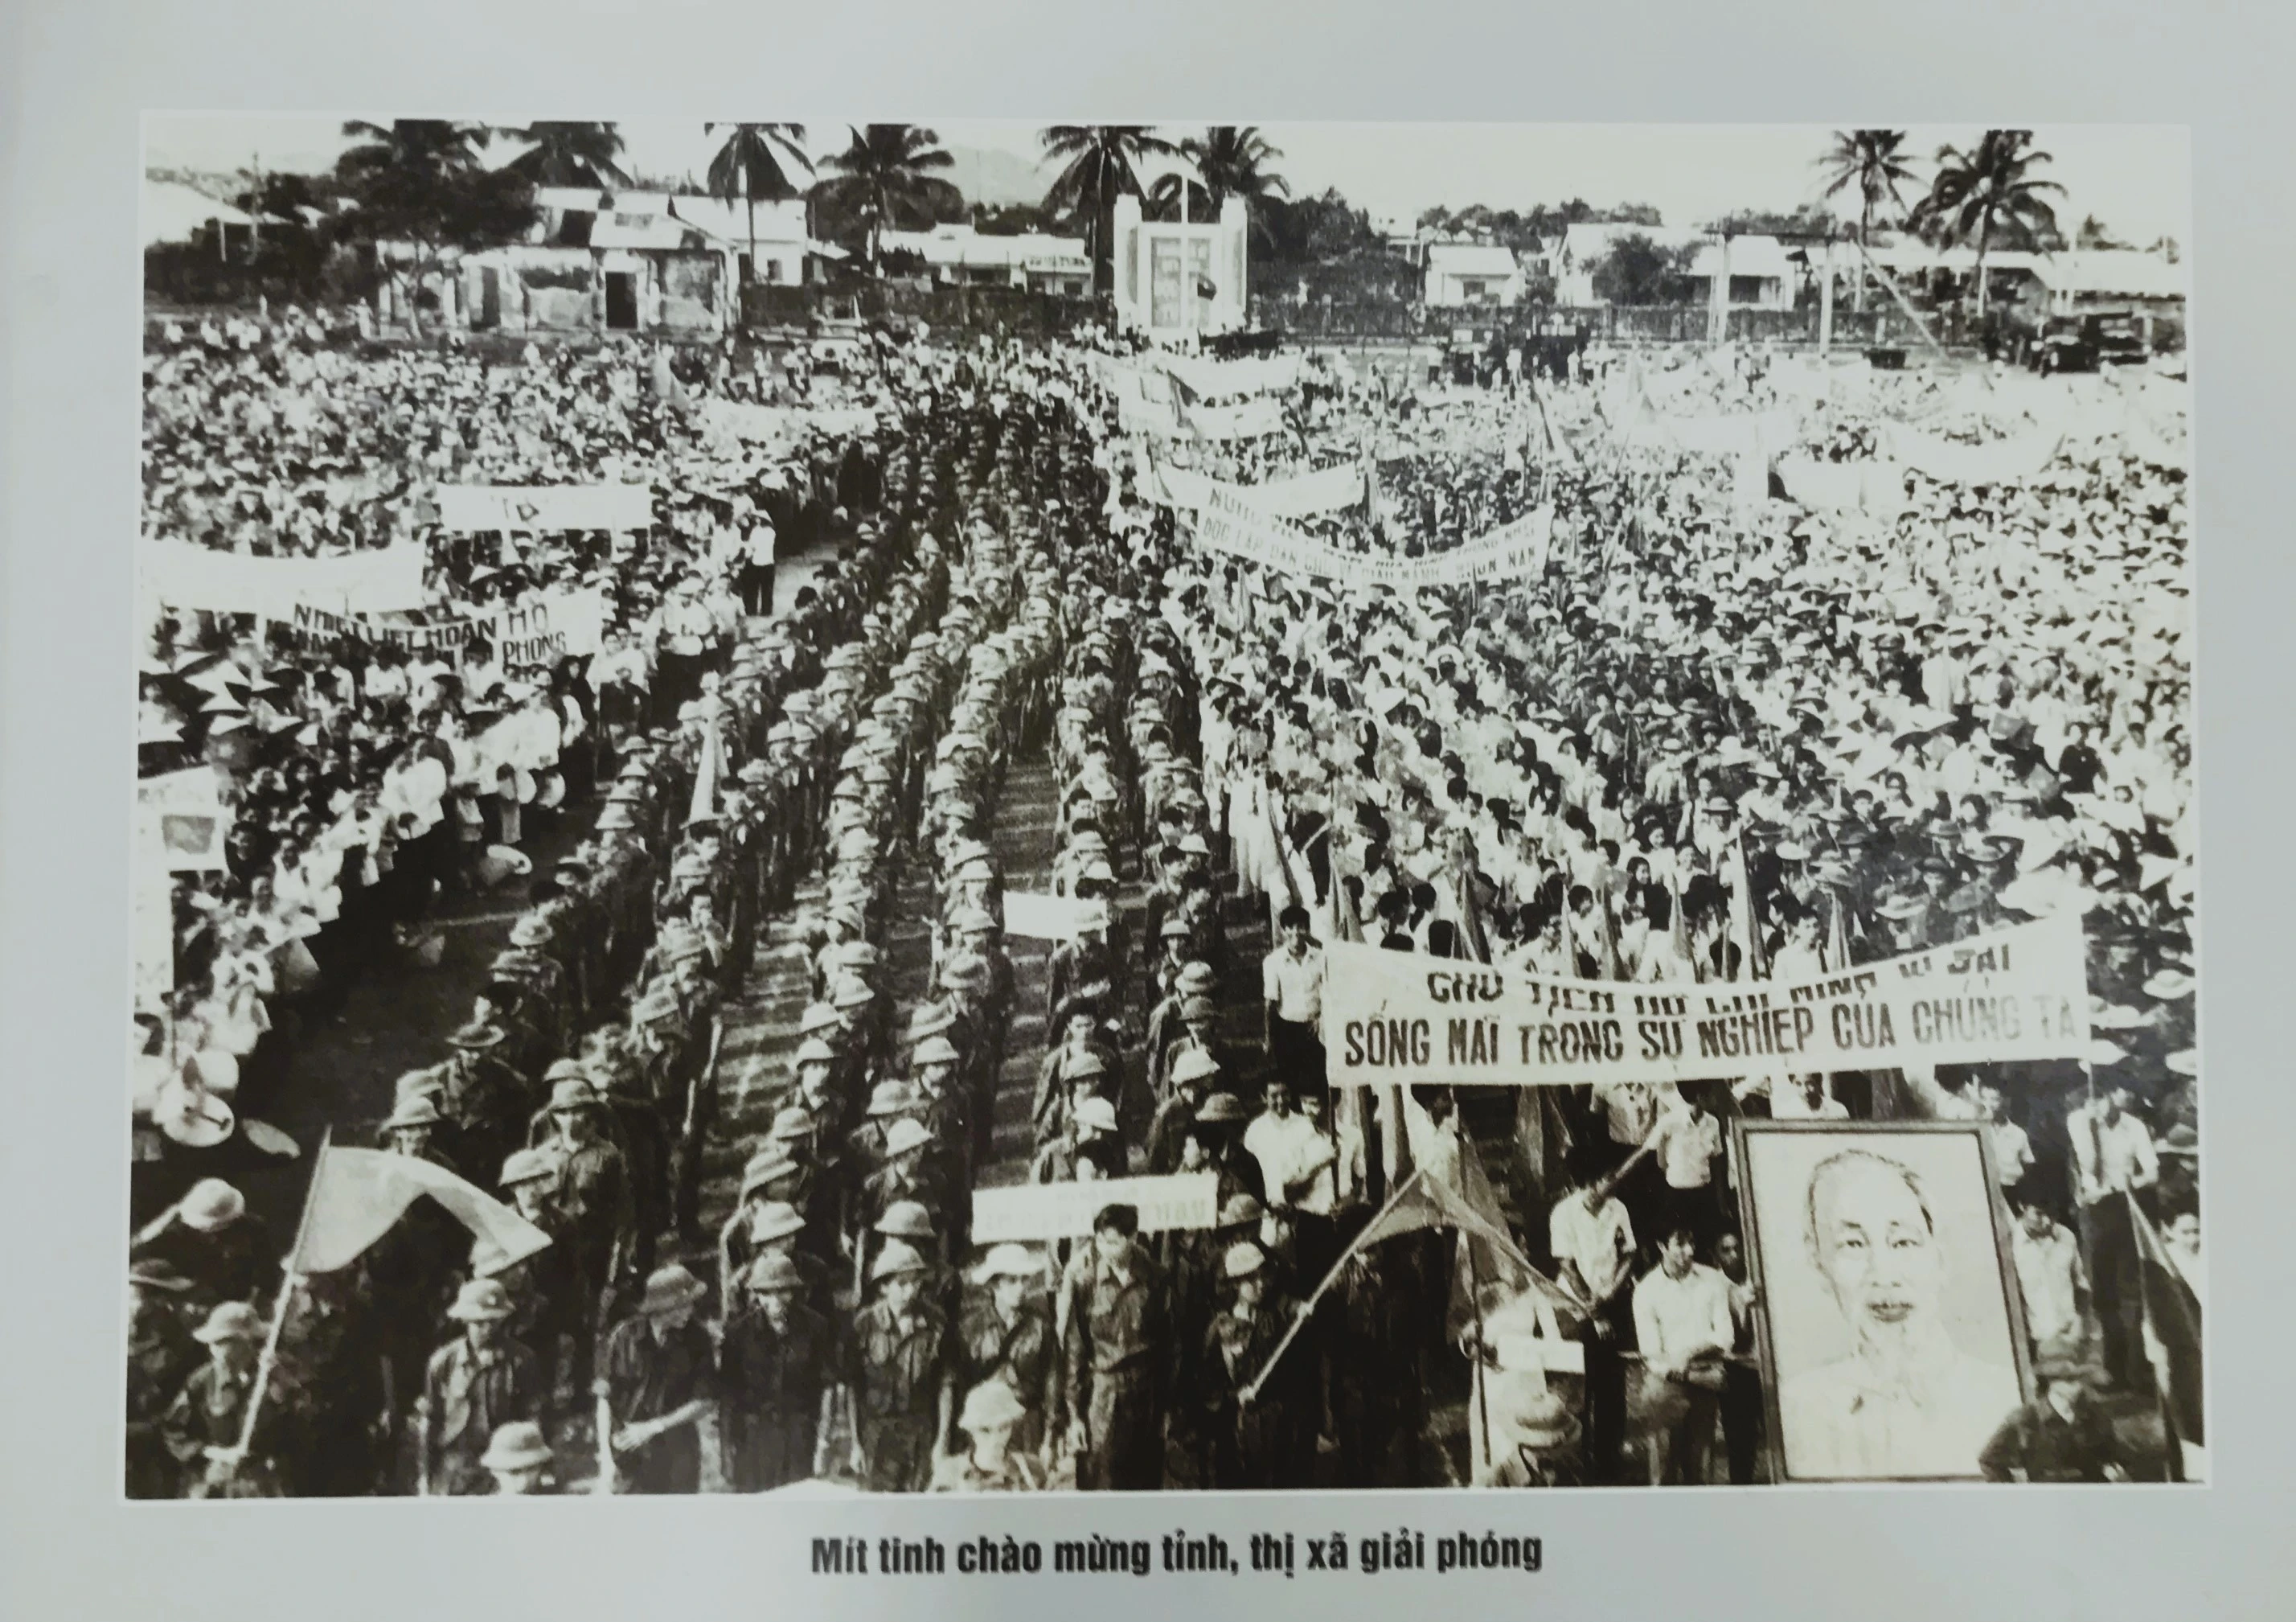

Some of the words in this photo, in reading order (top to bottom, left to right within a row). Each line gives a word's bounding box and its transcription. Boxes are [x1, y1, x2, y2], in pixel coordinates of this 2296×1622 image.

[1518, 1019, 1623, 1065] TRONG
[2032, 995, 2077, 1041] TA
[812, 1535, 867, 1575] Mít
[879, 1535, 945, 1575] tinh
[957, 1533, 1043, 1574] chào
[1054, 1532, 1150, 1576] mừng
[1163, 1528, 1239, 1576] tỉnh,
[1251, 1532, 1294, 1579] thị
[1306, 1530, 1348, 1571] xã
[1360, 1526, 1425, 1574] giải
[1437, 1530, 1543, 1574] phóng
